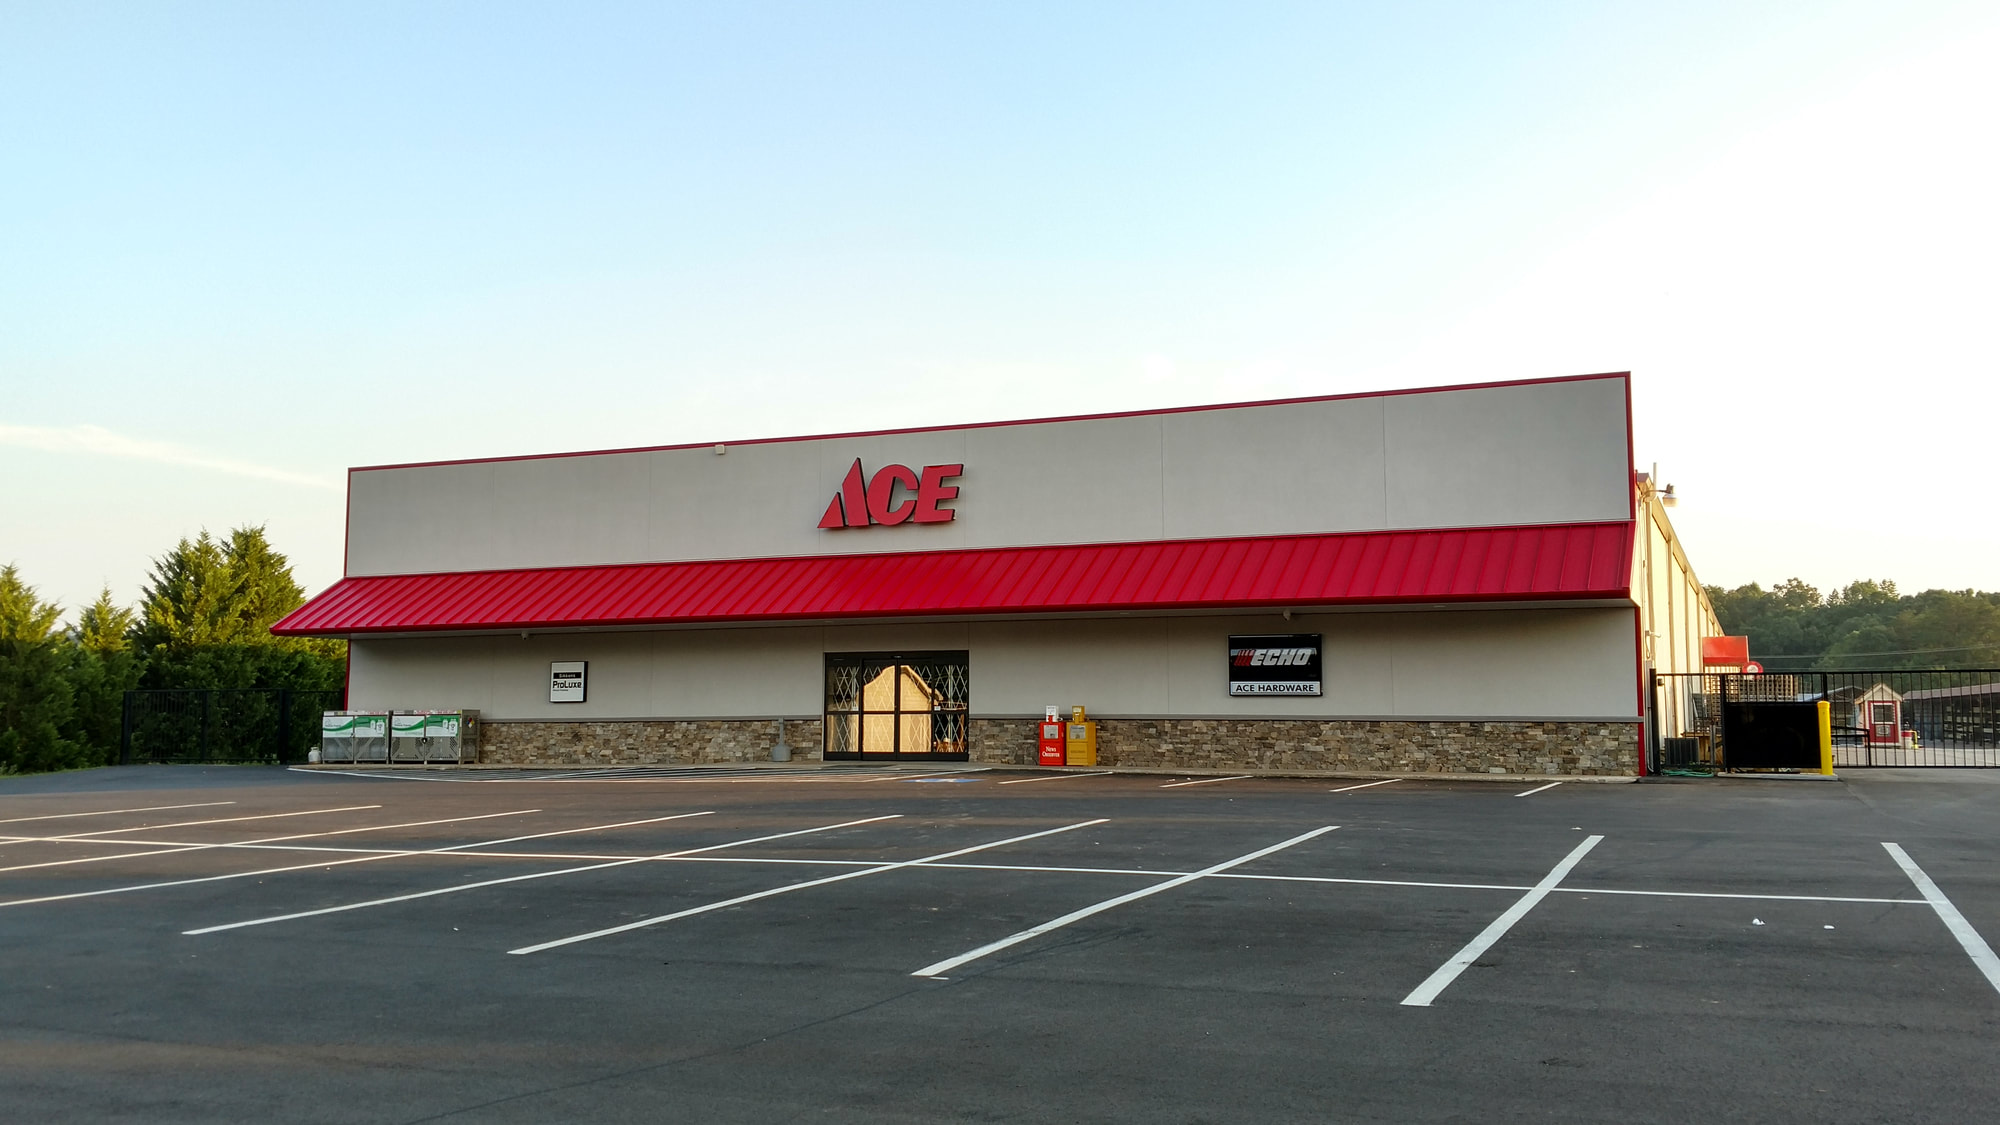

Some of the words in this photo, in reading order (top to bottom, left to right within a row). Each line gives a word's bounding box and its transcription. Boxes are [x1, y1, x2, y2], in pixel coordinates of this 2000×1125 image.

[817, 457, 964, 528] ACE
[1250, 648, 1312, 666] ECHO
[553, 680, 582, 688] ProLuxe
[1236, 684, 1255, 692] ACE
[1258, 684, 1314, 692] HARDWARE
